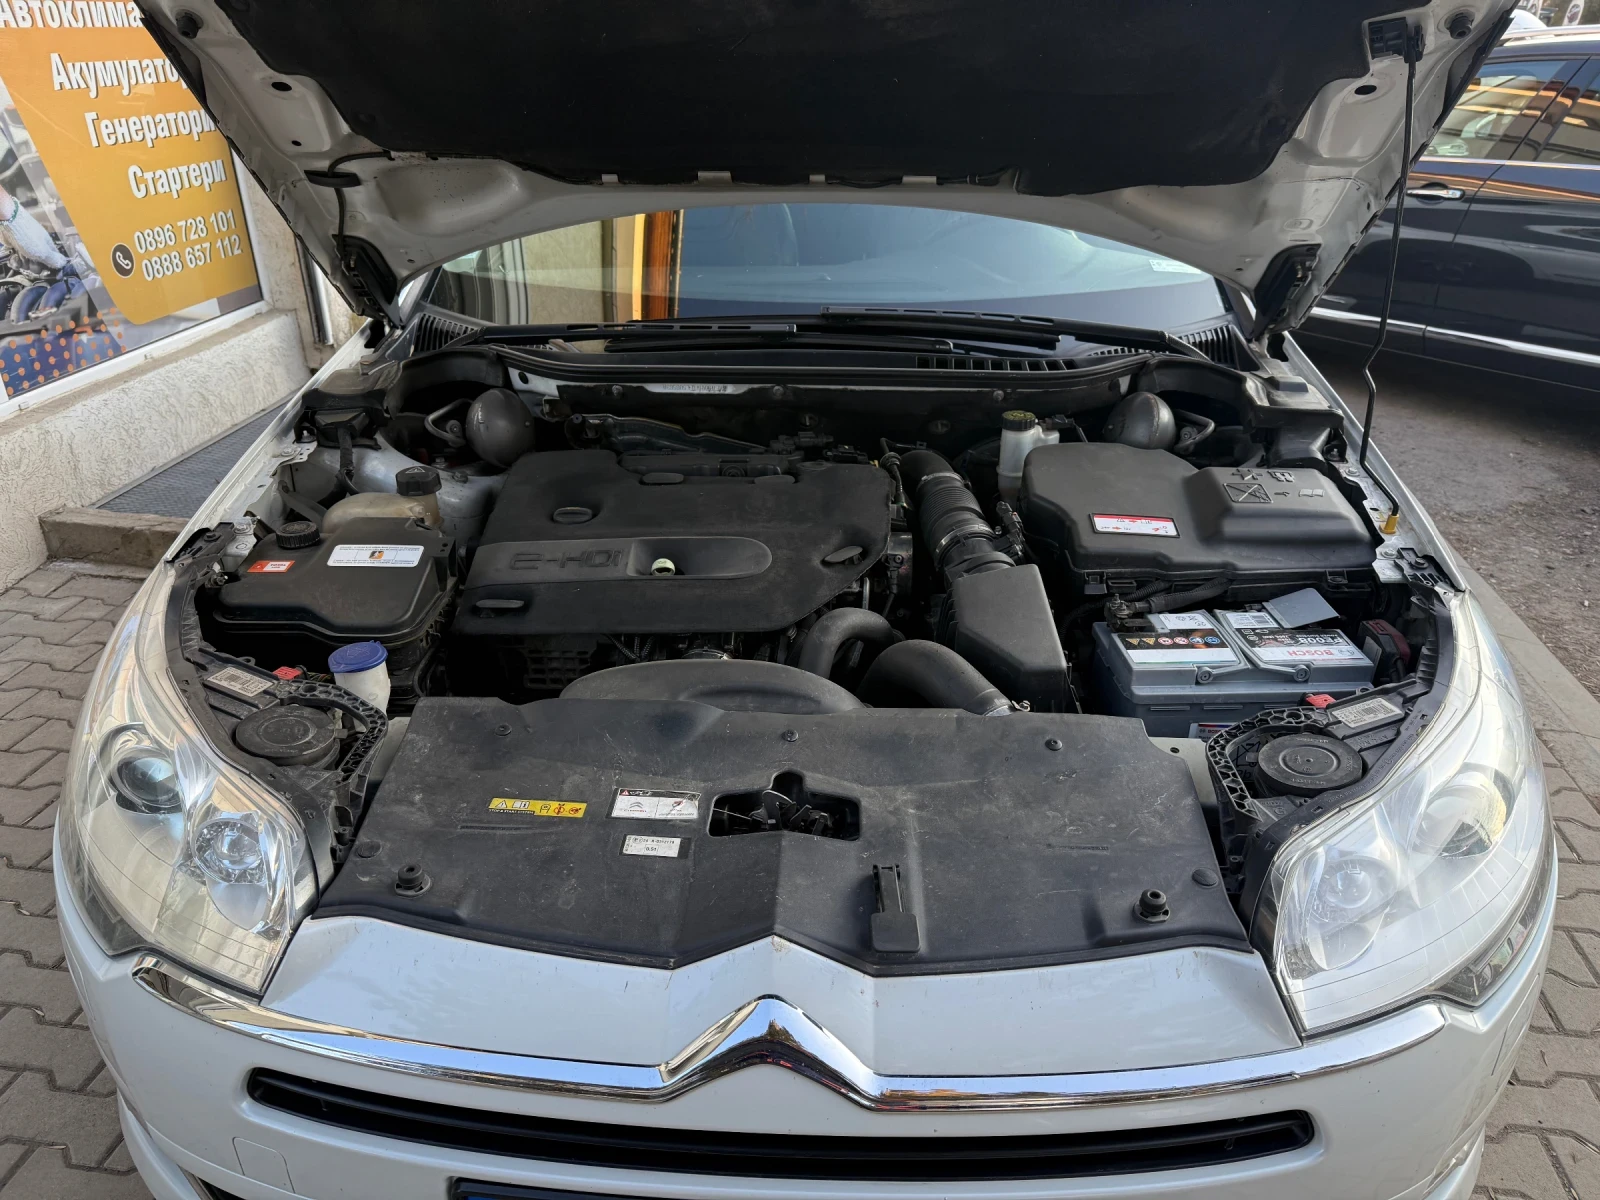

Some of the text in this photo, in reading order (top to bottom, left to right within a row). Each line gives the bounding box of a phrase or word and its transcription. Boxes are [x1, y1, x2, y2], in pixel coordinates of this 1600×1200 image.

[84, 110, 217, 148] Генератори
[128, 159, 227, 199] Стартери
[134, 209, 237, 254] 0896 728 101
[142, 234, 243, 281] 0888 657 112
[1287, 649, 1335, 657] BOSCH
